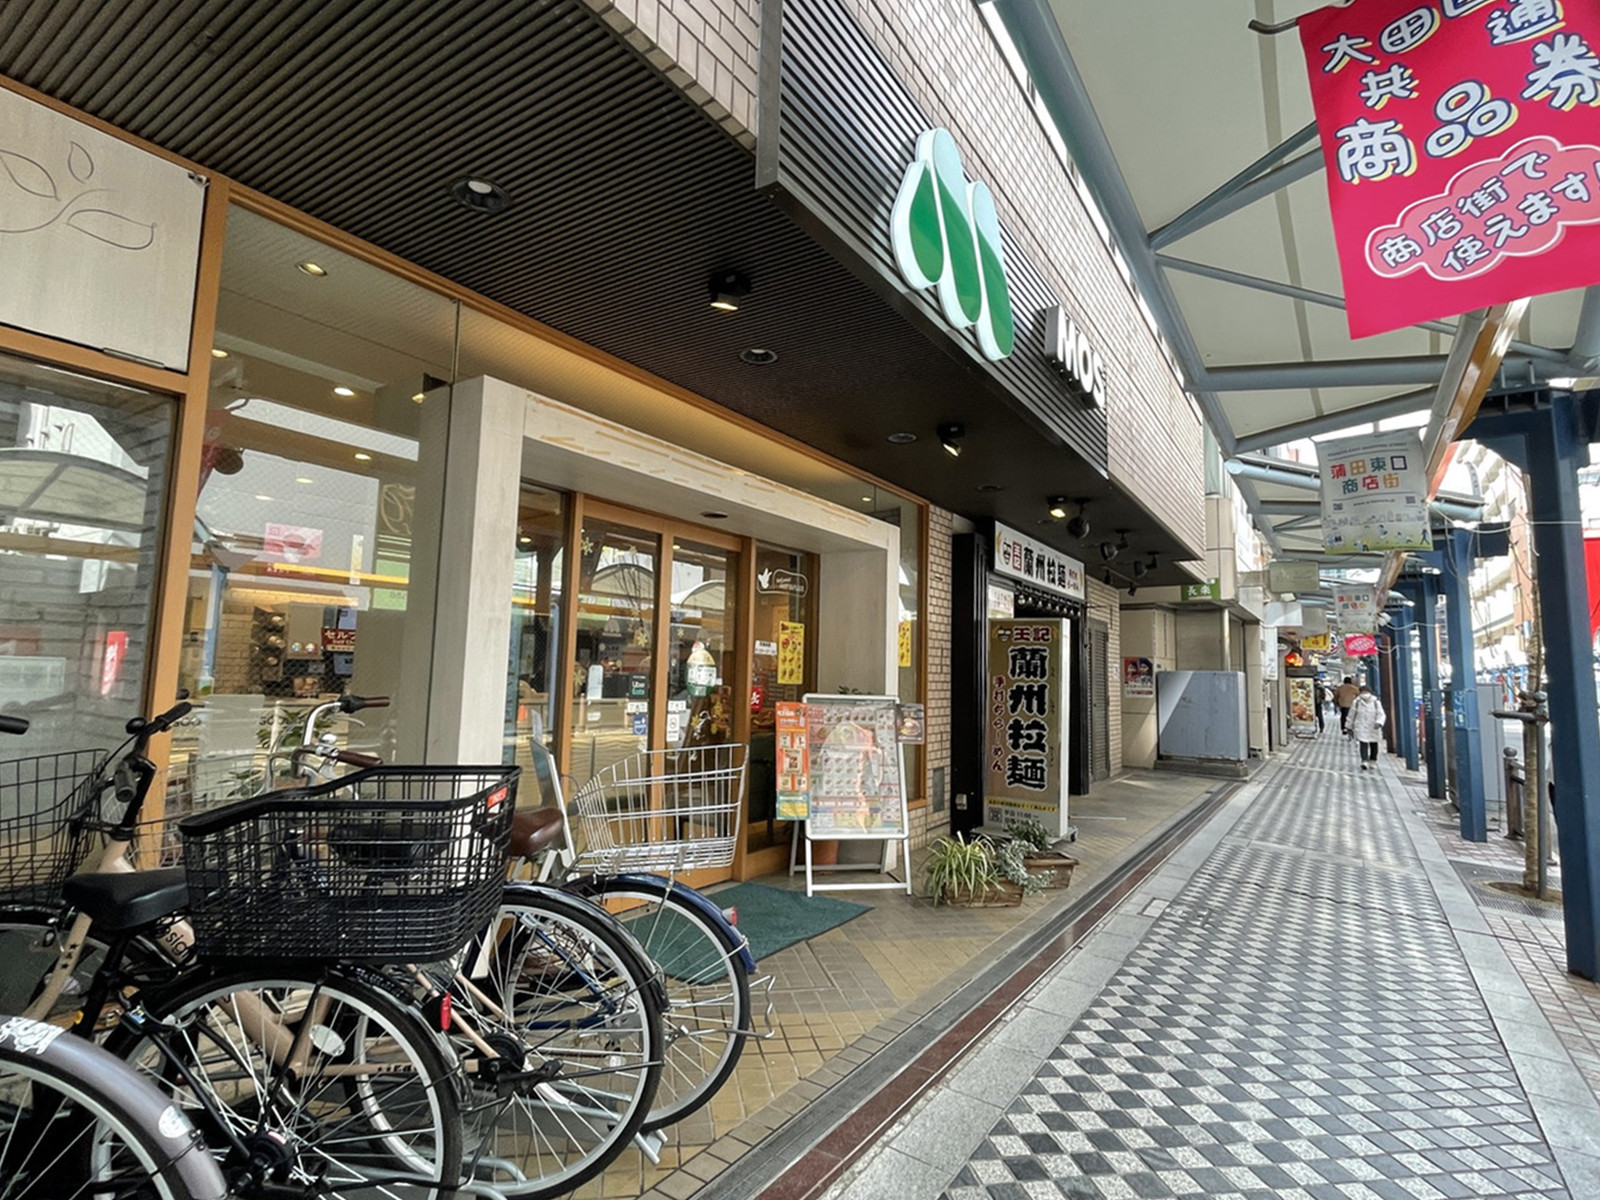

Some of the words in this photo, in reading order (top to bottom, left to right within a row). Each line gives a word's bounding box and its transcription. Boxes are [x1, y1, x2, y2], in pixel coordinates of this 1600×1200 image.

[1336, 32, 1600, 183] 商品券
[1377, 151, 1551, 268] 商店街で
[1055, 303, 1106, 409] MOS
[1330, 455, 1408, 479] 蒲田東口
[1342, 473, 1400, 495] 商店街
[1012, 625, 1051, 643] 王記
[1005, 645, 1049, 792] 蘭州拉麺
